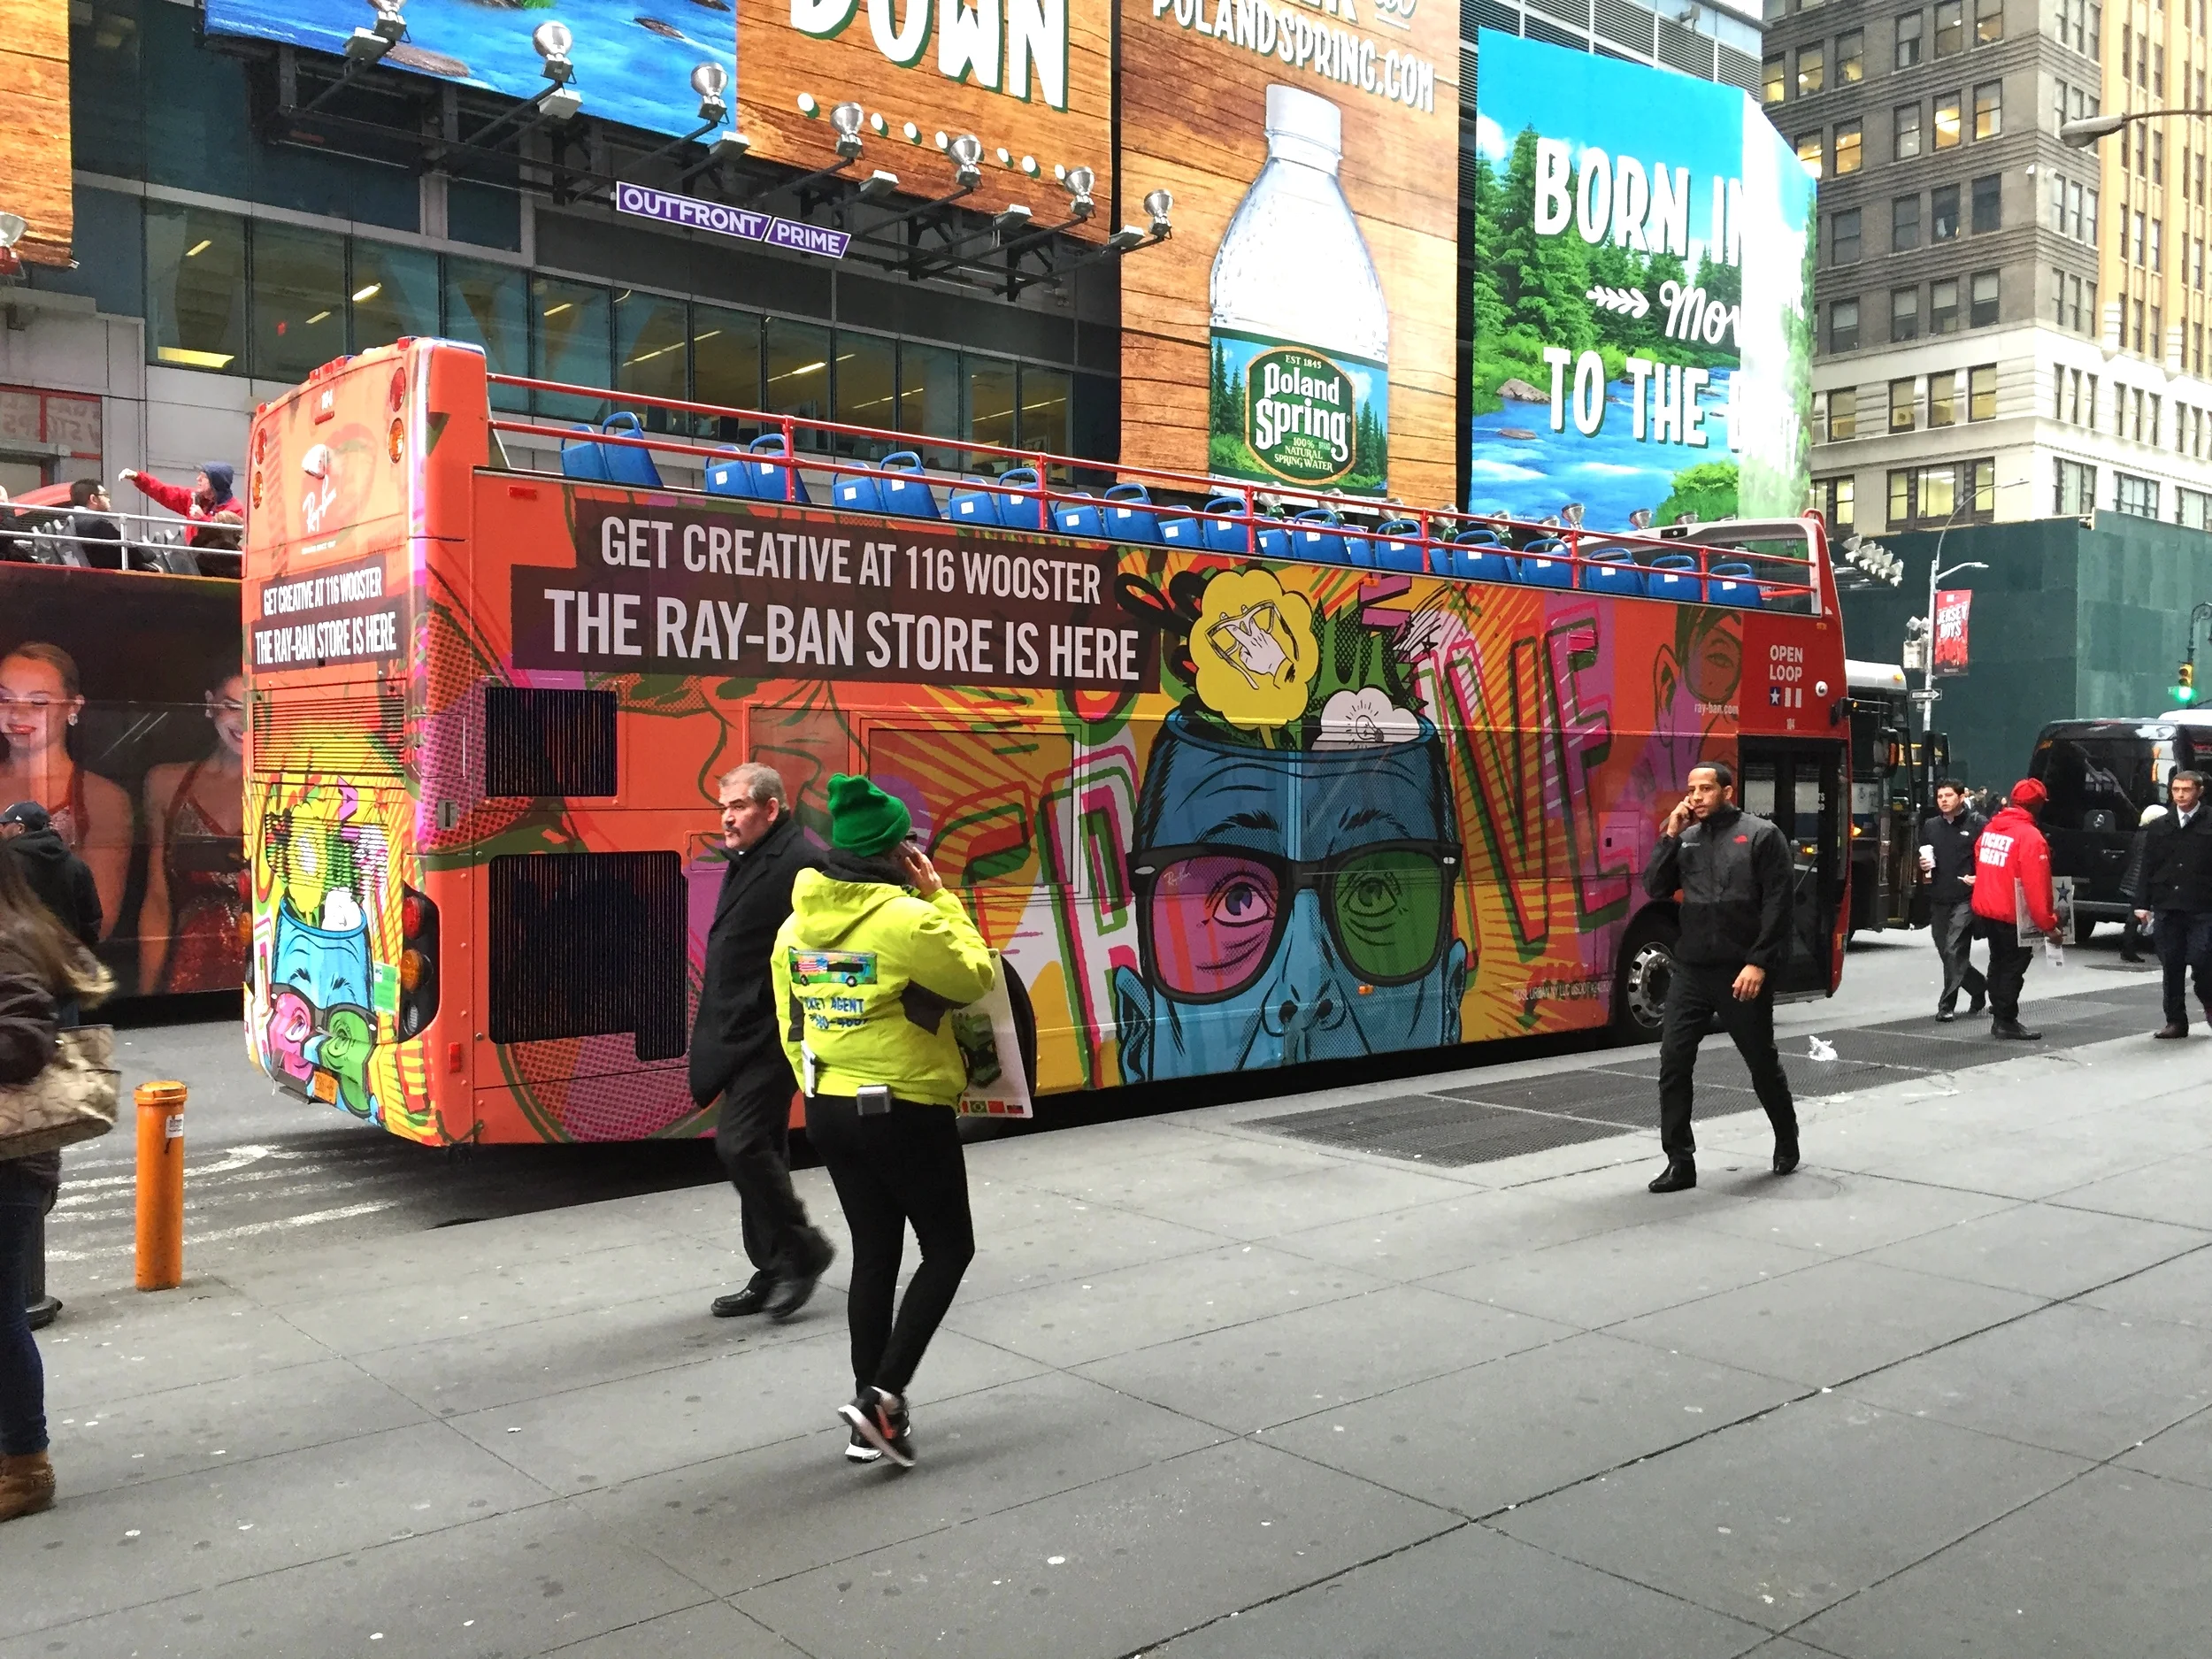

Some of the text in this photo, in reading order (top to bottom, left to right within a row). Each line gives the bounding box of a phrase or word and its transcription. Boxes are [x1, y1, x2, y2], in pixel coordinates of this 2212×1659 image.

[1534, 137, 1691, 260] BORN
[623, 188, 841, 254] OUTFRONT PRIME
[1285, 354, 1322, 369] EST 1845
[1263, 362, 1340, 405] Poland
[1543, 347, 1606, 438] TO
[1626, 357, 1710, 449] THE
[1255, 397, 1348, 463] Spring
[1293, 436, 1315, 449] 100%
[1274, 454, 1333, 473] SPRING WATER
[1285, 445, 1323, 460] NATURAL
[600, 515, 1102, 605] GET CREATIVE AT 116 WOOSTER
[264, 566, 382, 616] GET CREATIVE AT 116 WOOSTER
[255, 611, 397, 665] THE RAY-BAN STORE IS HERE
[544, 588, 1140, 681] THE RAY-BAN STORE IS HERE
[1770, 644, 1803, 664] OPEN
[1770, 664, 1802, 682] LOOP
[1694, 701, 1740, 716] ray-ban.com
[1980, 831, 2015, 853] TICKET
[831, 996, 864, 1013] AGENT
